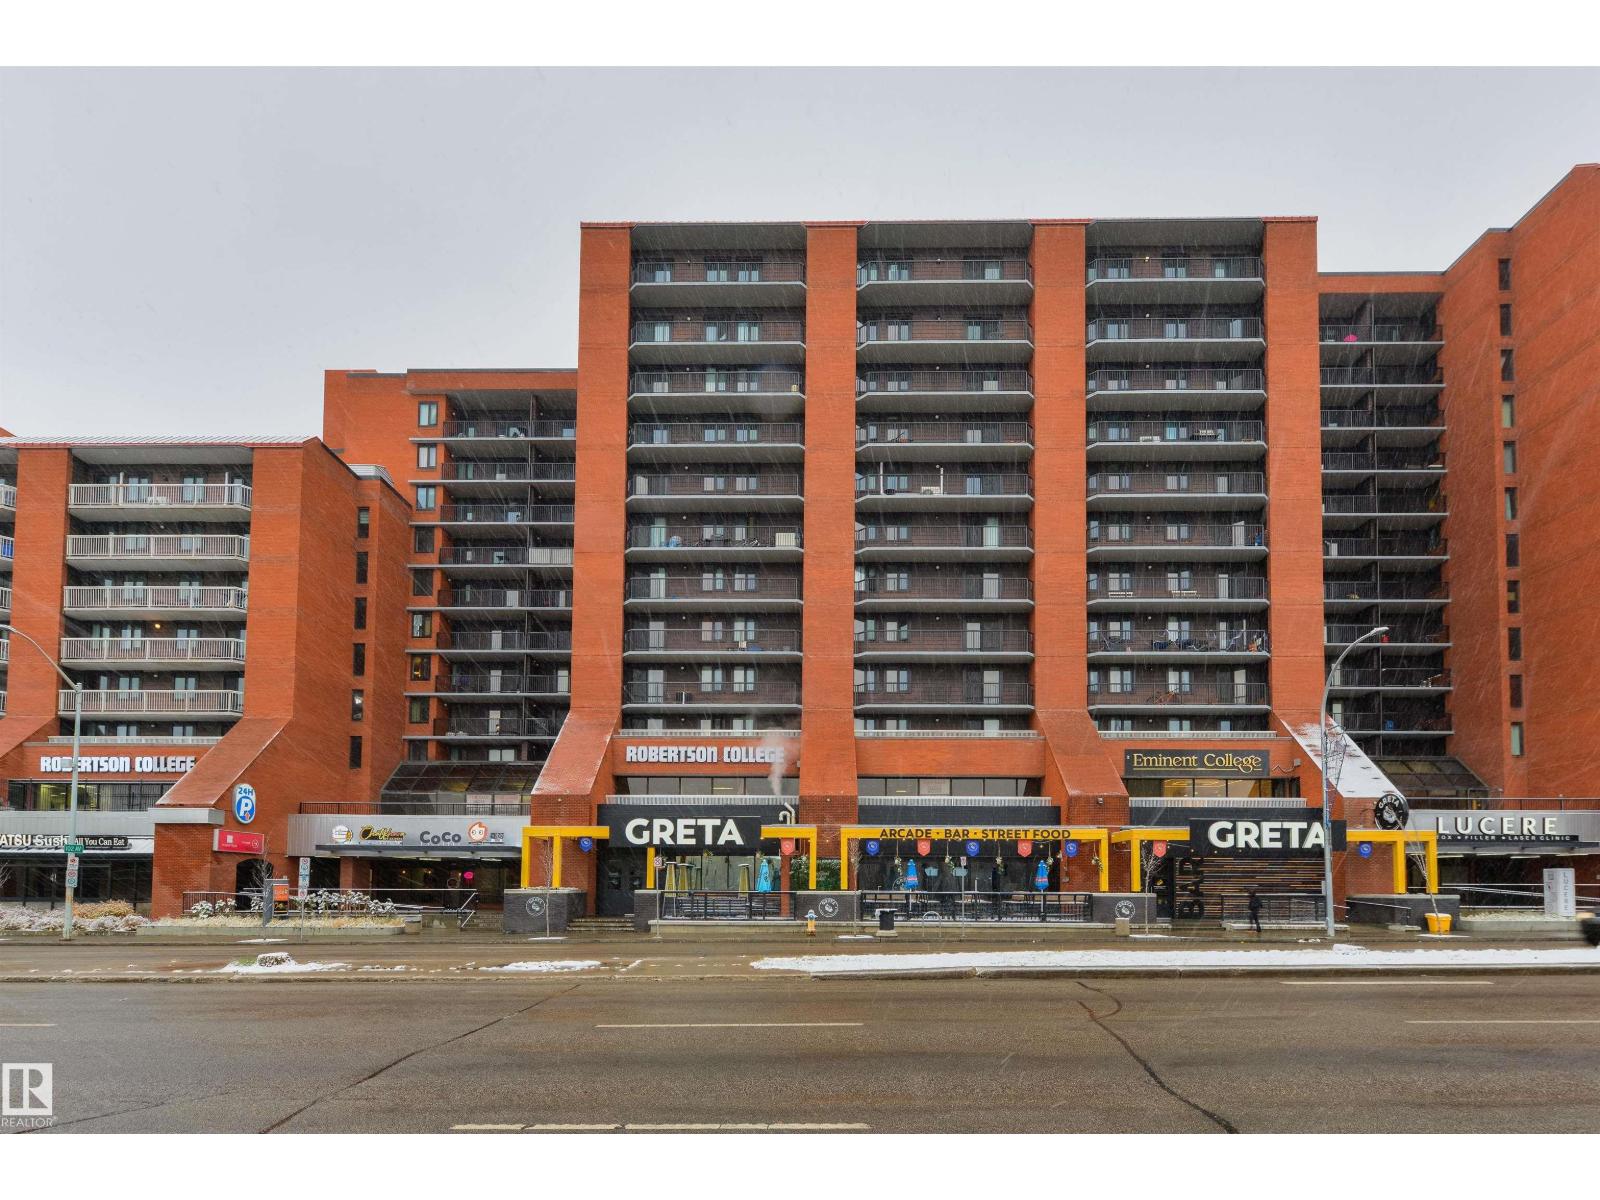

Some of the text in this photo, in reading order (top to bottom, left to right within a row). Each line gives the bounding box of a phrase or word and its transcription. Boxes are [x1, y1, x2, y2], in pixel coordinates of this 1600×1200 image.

[626, 746, 785, 762] ROBERTSON COLLEGE
[135, 756, 197, 772] COLLEGE
[1133, 753, 1262, 773] Eminent College
[238, 787, 254, 795] 24H
[1379, 795, 1400, 808] GRETA
[625, 818, 745, 845] GRETA
[880, 828, 1071, 839] ARCADE BAR STREET FOOD
[1436, 816, 1558, 835] LUCERE
[34, 834, 69, 847] Sush
[85, 838, 97, 846] You
[98, 838, 112, 846] Can
[113, 838, 125, 846] Eat
[1207, 821, 1326, 849] GRETA
